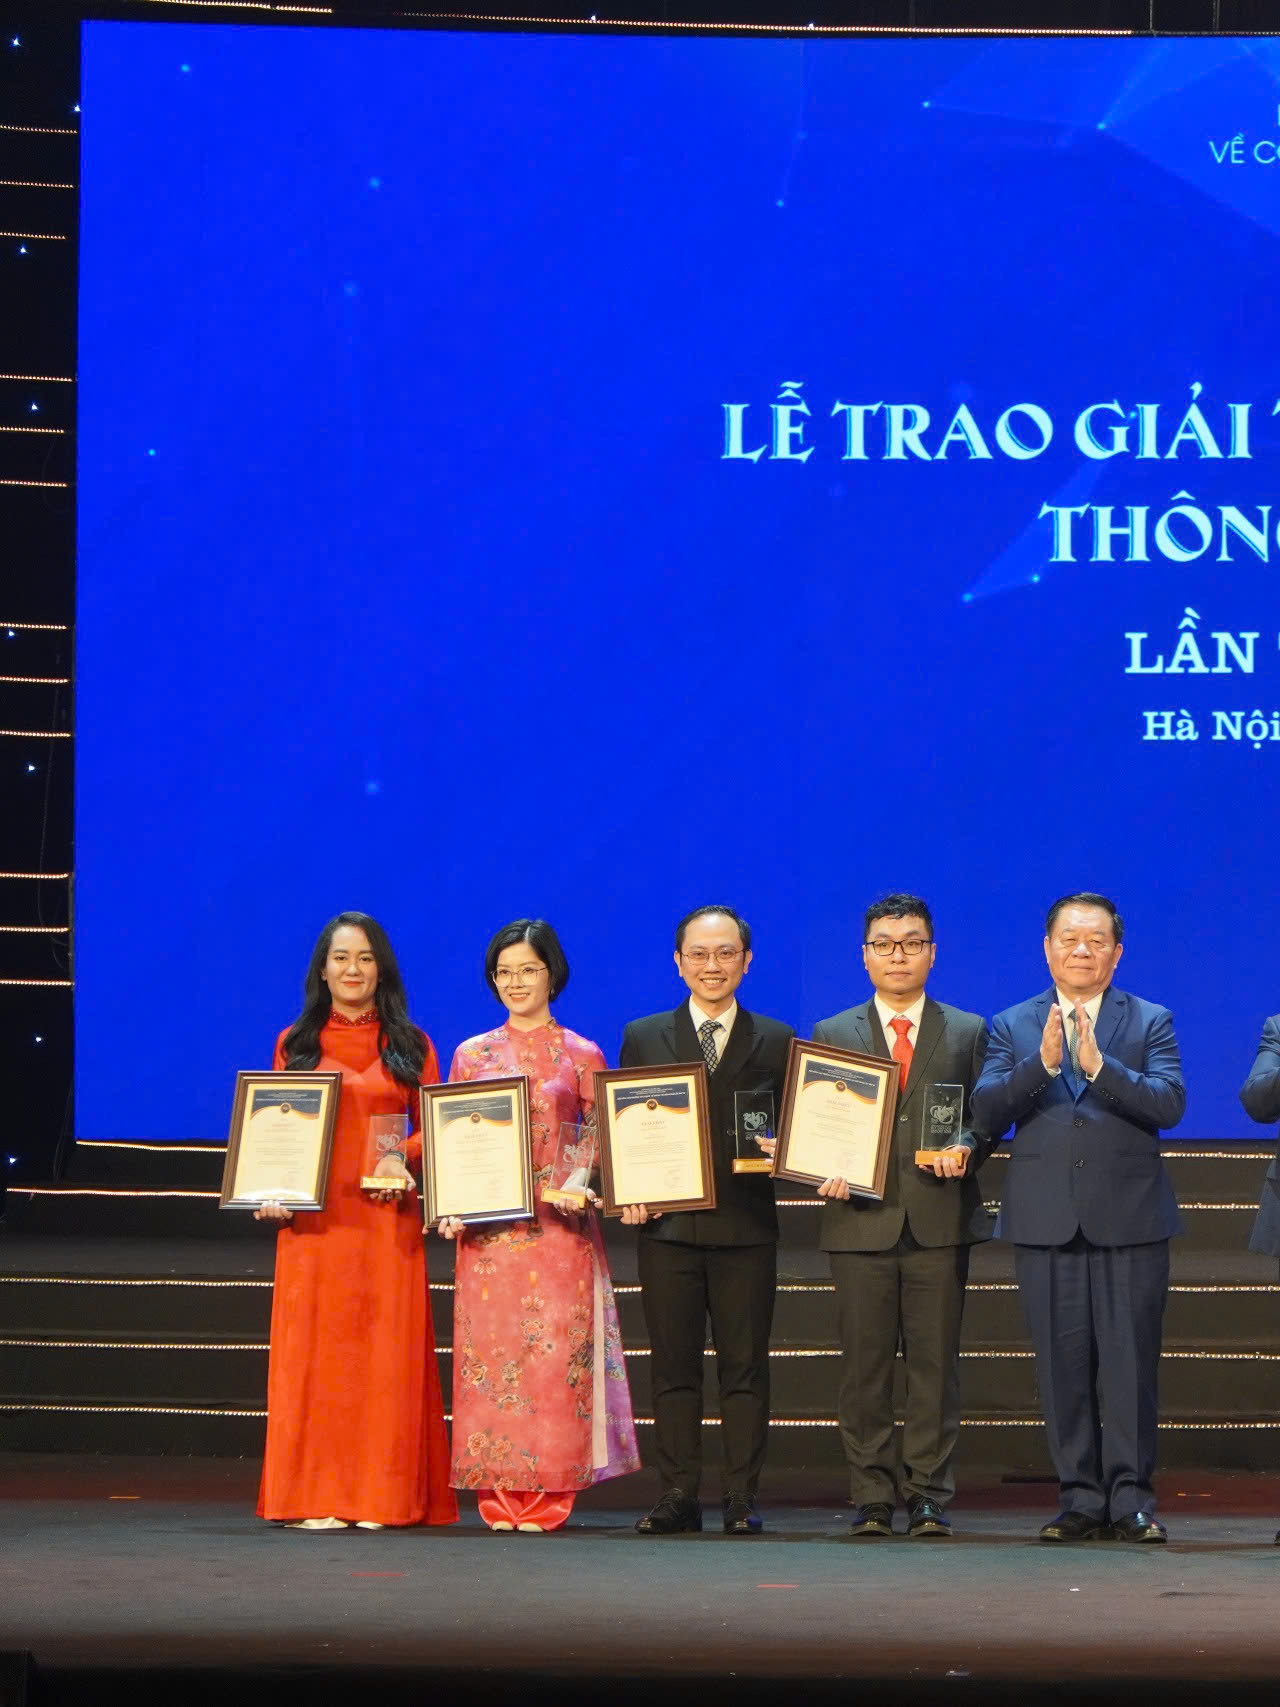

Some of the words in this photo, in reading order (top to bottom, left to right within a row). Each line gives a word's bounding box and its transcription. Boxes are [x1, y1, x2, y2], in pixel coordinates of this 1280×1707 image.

[1208, 133, 1245, 164] VỀ
[722, 382, 814, 462] LỄ
[832, 401, 1054, 462] TRAO
[1074, 382, 1252, 460] GIẢI
[1124, 607, 1260, 675] LẦN
[1142, 709, 1199, 741] Hà
